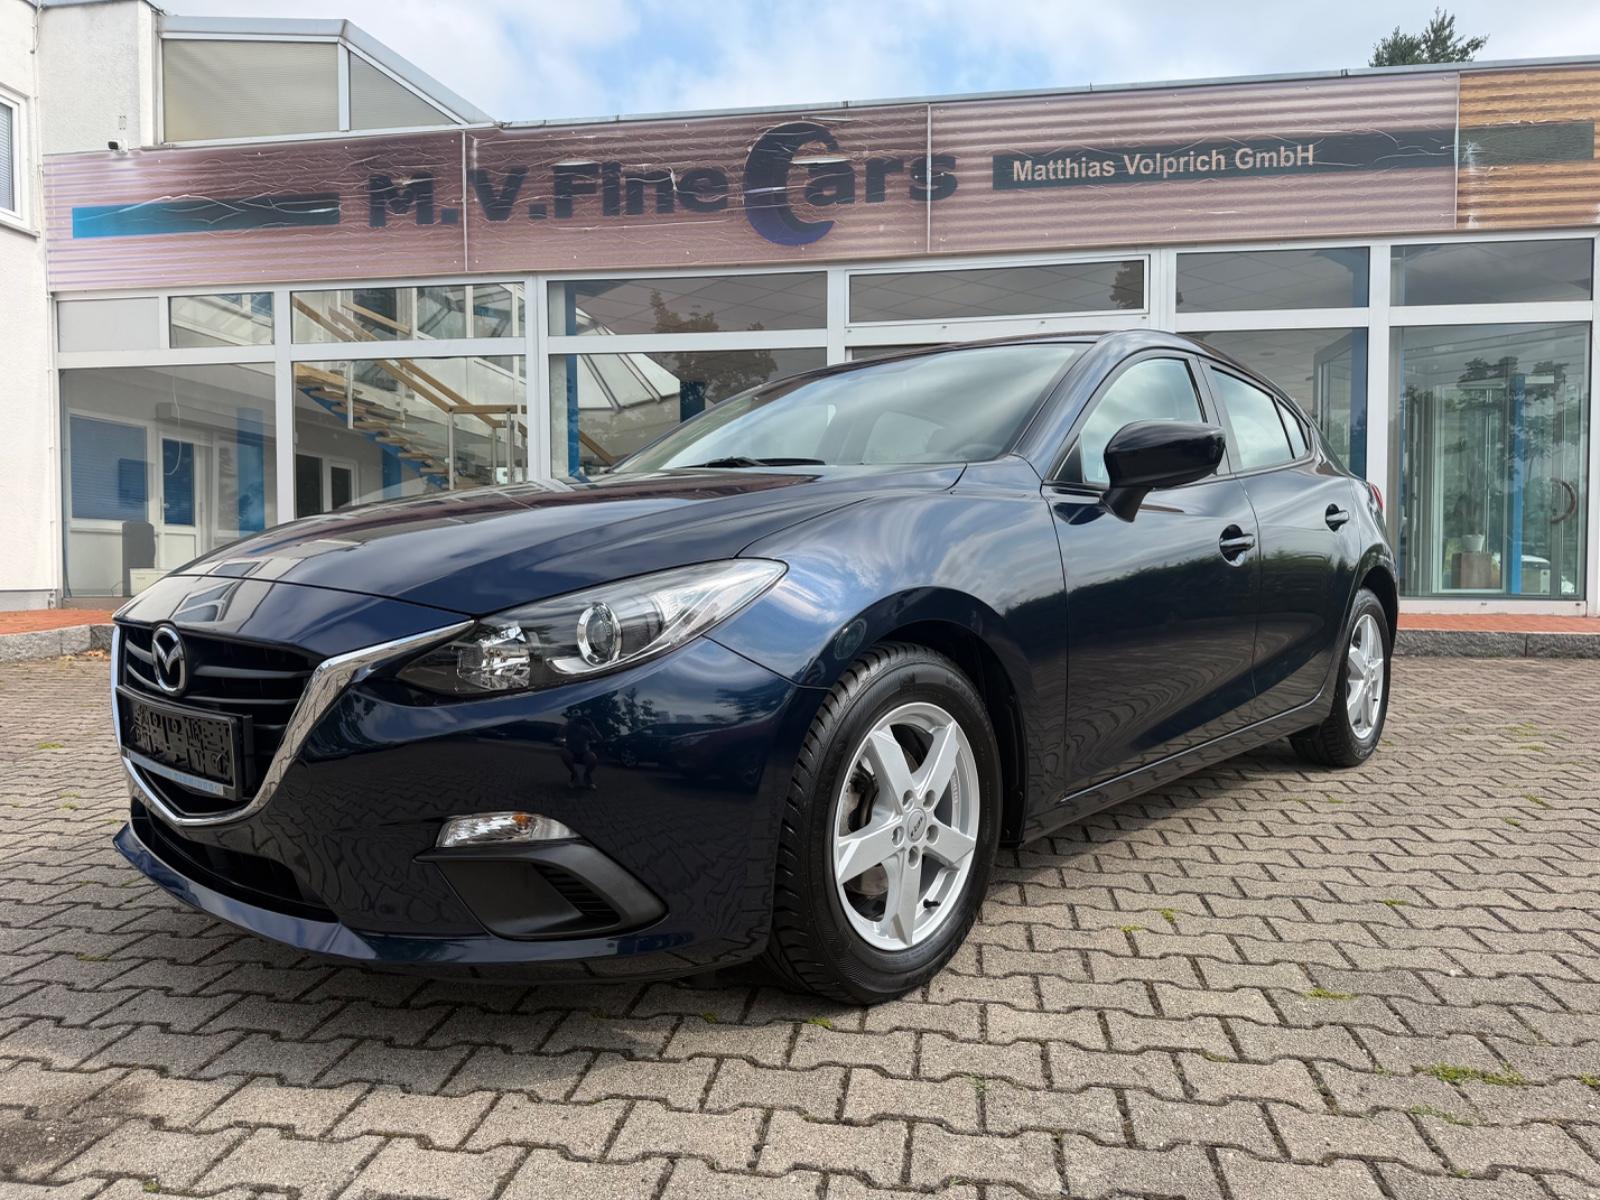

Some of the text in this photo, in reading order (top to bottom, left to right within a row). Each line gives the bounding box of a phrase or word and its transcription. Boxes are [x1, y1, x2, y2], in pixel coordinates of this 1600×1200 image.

[1012, 144, 1315, 182] Matthias Volprich GmbH
